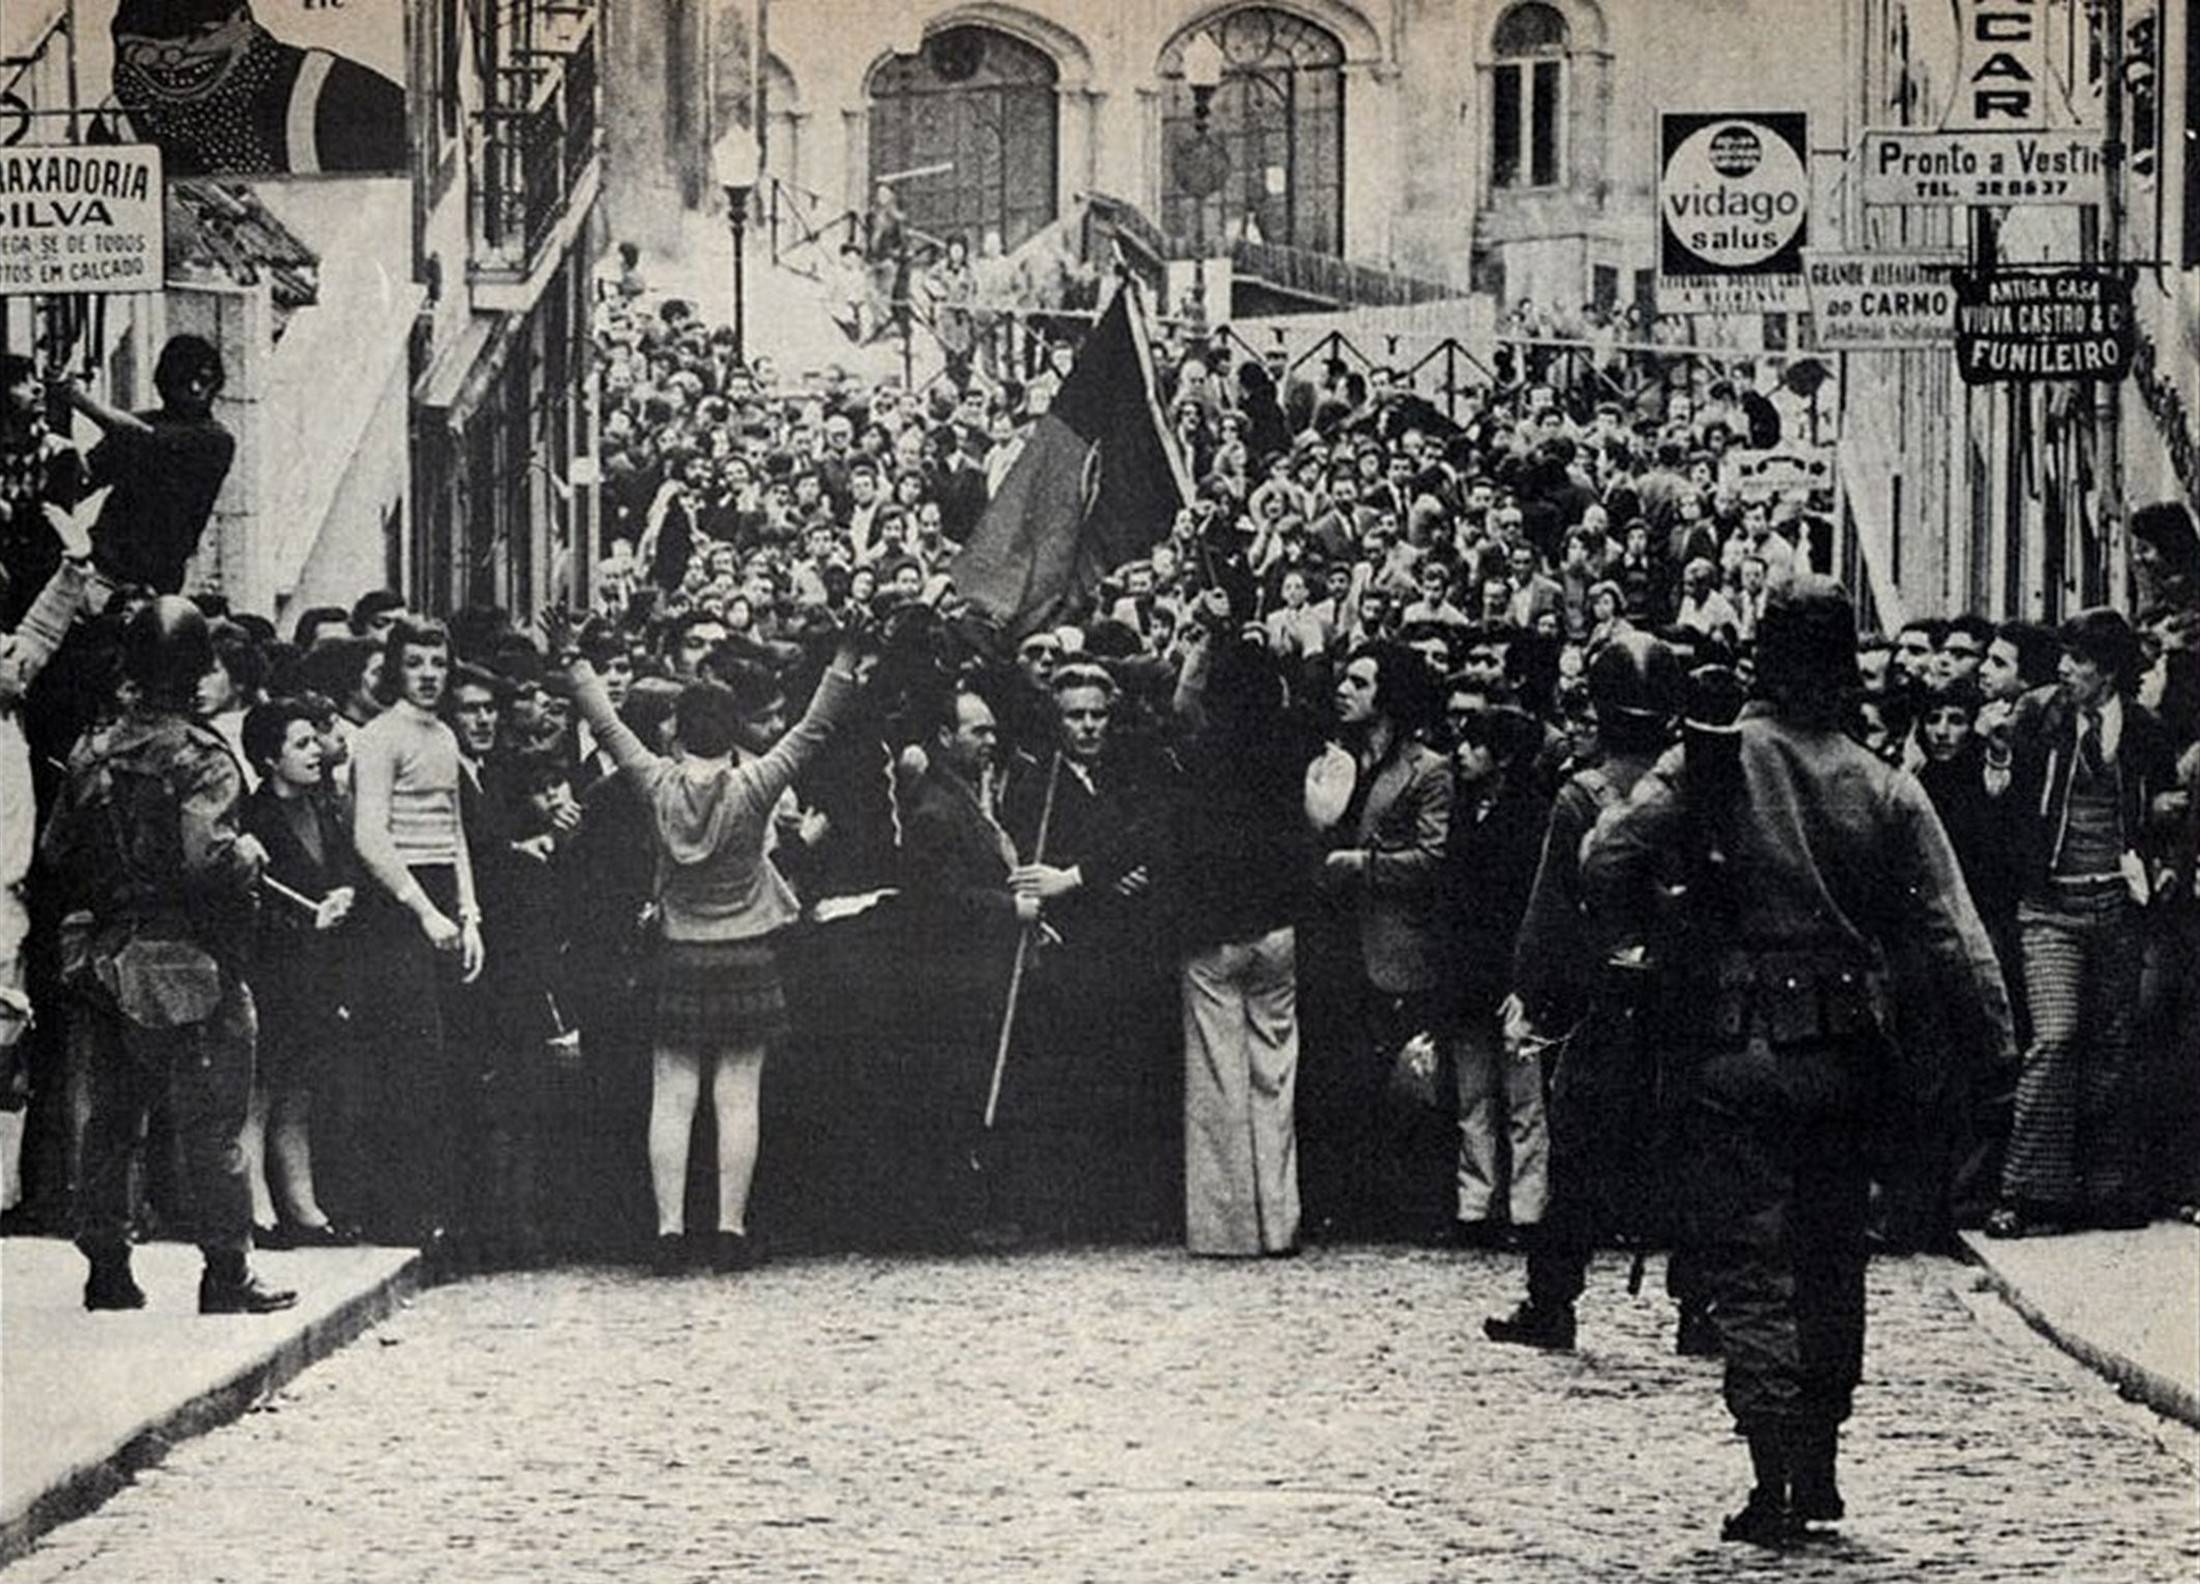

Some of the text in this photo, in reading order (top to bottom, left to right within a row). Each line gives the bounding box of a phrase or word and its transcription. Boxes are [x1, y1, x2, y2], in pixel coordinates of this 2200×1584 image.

[1971, 0, 2035, 118] CAR
[1879, 141, 1977, 175] Pronto
[1989, 153, 2005, 174] a
[1916, 180, 1959, 196] TEL.
[0, 201, 114, 228] ILVA
[1670, 183, 1799, 225] vidago
[67, 234, 87, 253] DE
[95, 234, 146, 253] TODOS
[1692, 225, 1778, 249] salus
[0, 263, 33, 283] TOS
[40, 264, 63, 283] EM
[1860, 291, 1948, 317] CARMO
[1989, 279, 2100, 303] ANTIGA CASA
[2018, 304, 2086, 333] CASTRO
[2090, 305, 2103, 332] &
[1971, 338, 2119, 372] FUNILEIRO
